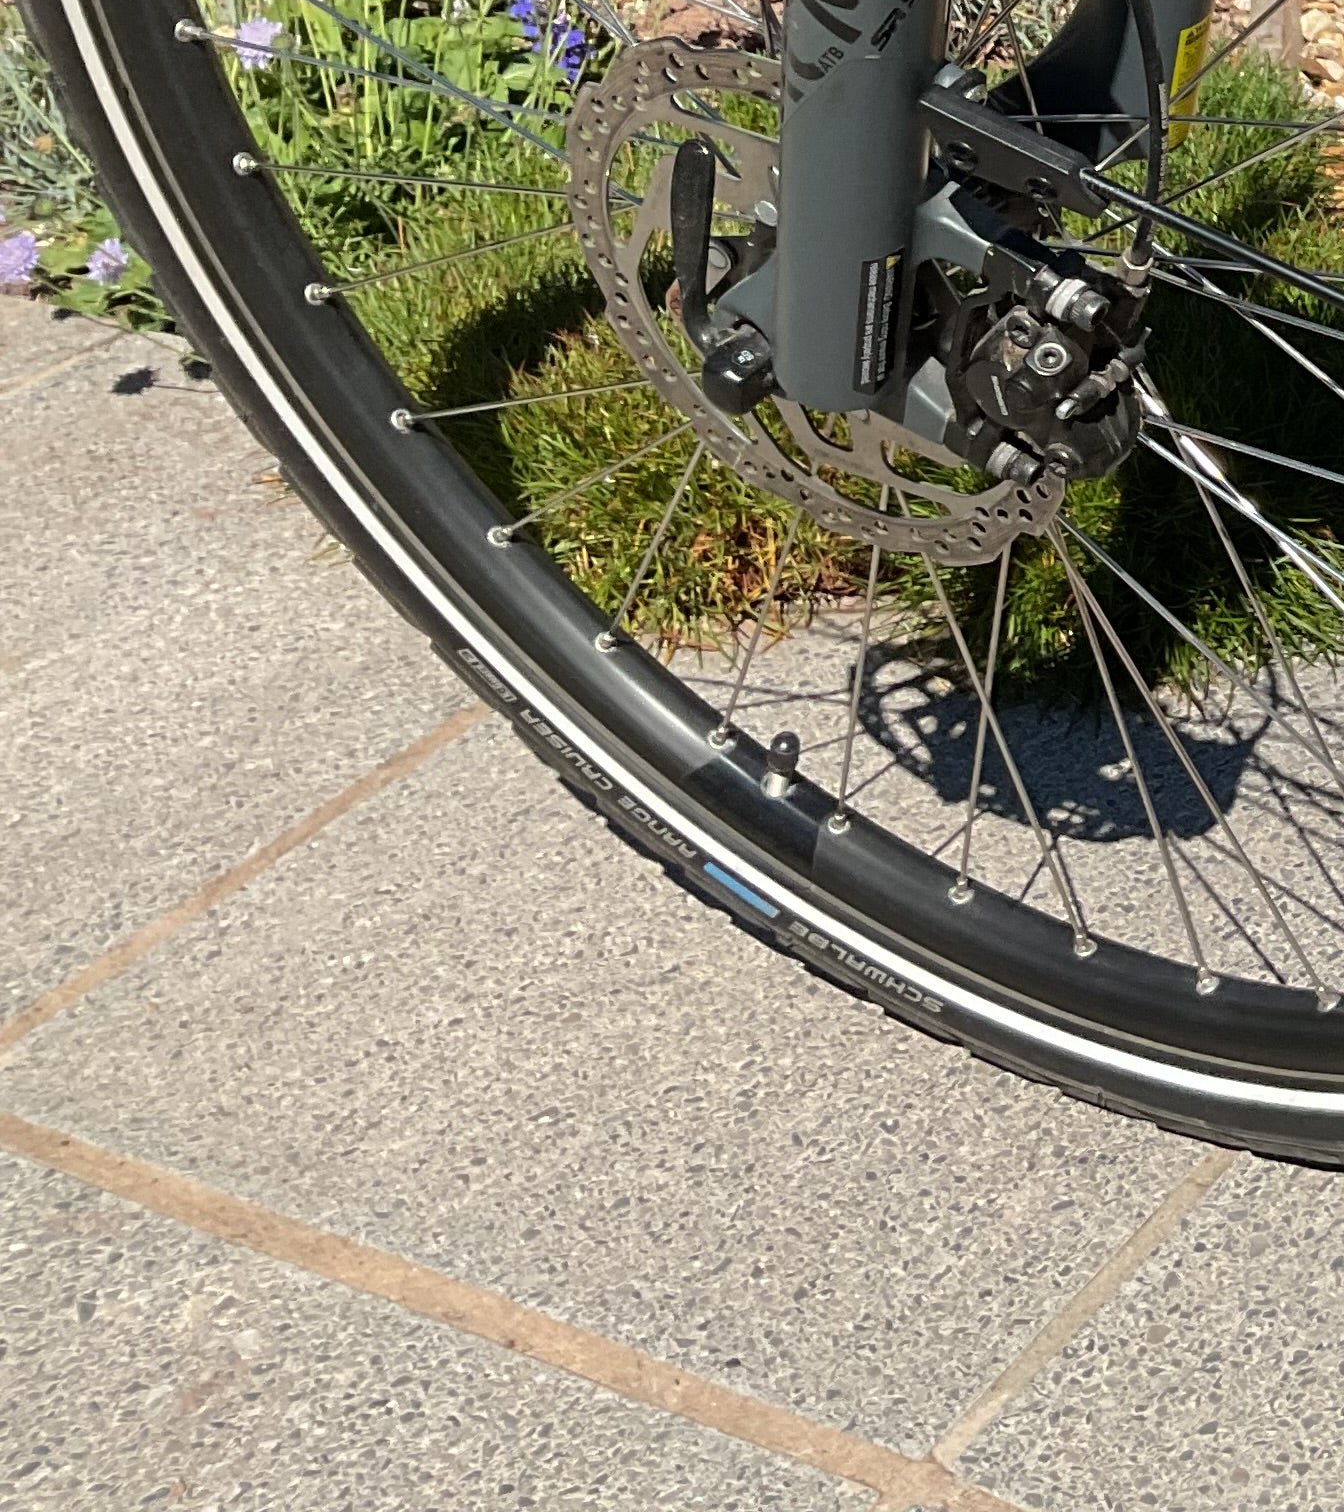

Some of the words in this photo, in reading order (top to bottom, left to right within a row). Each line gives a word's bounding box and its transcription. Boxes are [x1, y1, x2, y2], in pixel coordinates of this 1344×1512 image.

[817, 46, 845, 75] ATB
[520, 708, 614, 791] CRUISER
[617, 795, 697, 859] RANGE
[789, 920, 944, 1013] SCHWALBE
